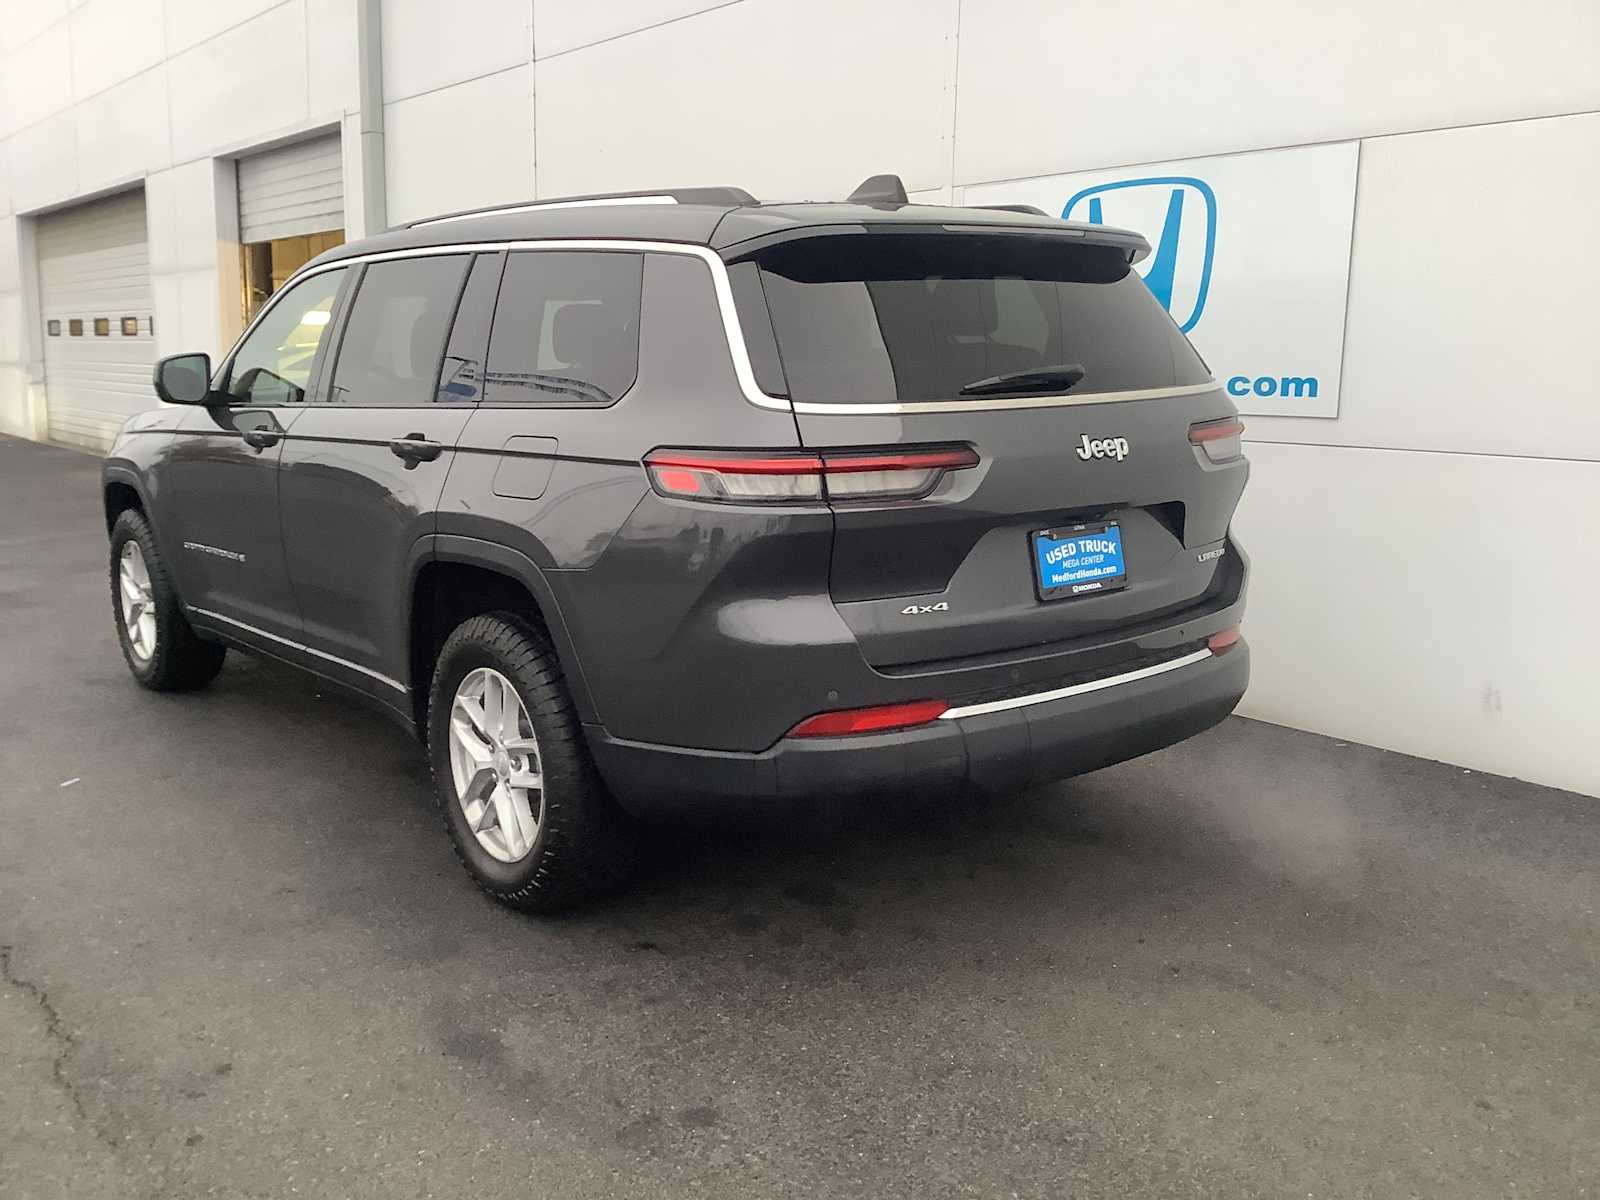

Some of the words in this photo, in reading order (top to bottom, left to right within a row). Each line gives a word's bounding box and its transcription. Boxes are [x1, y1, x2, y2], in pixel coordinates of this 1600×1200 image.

[1076, 434, 1129, 461] Jeep
[1045, 542, 1077, 565] USED
[1078, 539, 1117, 555] TRUCK
[1062, 559, 1080, 569] MEGA
[1081, 554, 1105, 566] CENTER
[1052, 565, 1117, 583] MedfordHonda.com
[901, 602, 949, 614] 4x4
